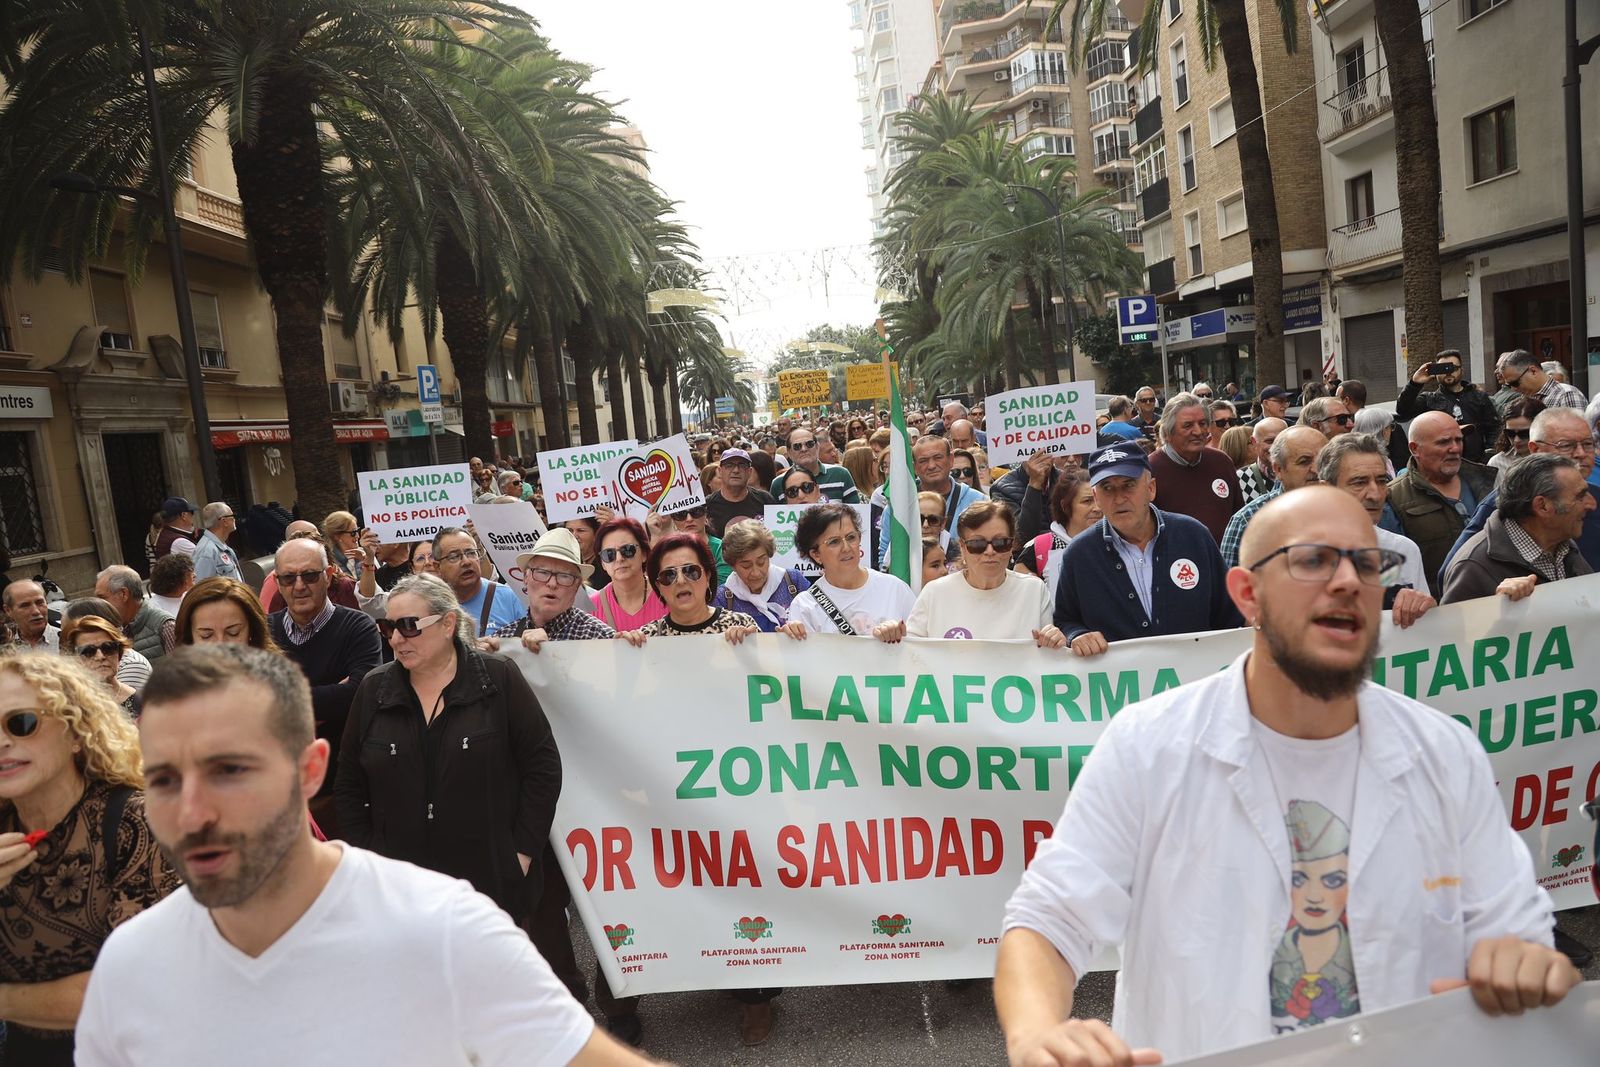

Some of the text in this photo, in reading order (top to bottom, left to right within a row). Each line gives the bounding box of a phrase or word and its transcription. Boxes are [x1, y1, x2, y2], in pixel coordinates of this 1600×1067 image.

[1128, 299, 1147, 324] P
[1131, 332, 1147, 341] LIBRE
[422, 370, 434, 399] P
[999, 390, 1079, 414] SANIDAD
[1004, 409, 1076, 430] PÚBLICA
[992, 424, 1091, 448] Y DE CALIDAD
[1017, 443, 1066, 457] ALAEDA
[548, 457, 567, 470] LA
[628, 460, 667, 482] SANIDAD
[369, 471, 465, 491] LA SANIDAD
[385, 489, 449, 506] PÚBLICA
[556, 490, 579, 503] NO
[583, 487, 598, 499] SE
[371, 506, 466, 524] NO ES POLÍTICA
[662, 500, 700, 513] ALAMEDA
[488, 529, 541, 544] Sanidad
[814, 591, 836, 614] BIMBA
[676, 742, 858, 799] ZONA
[1510, 765, 1574, 832] DE
[651, 827, 762, 888] UNA
[777, 817, 1004, 888] SANIDAD
[1562, 875, 1590, 887] NORTE
[701, 946, 807, 957] PLATAFORMA SANITARIA
[839, 940, 945, 951] PLATAFORMA SANITARIA
[622, 952, 669, 963] SANITARIA
[726, 957, 782, 967] ZONA NORTE
[864, 952, 921, 961] ZONA NORTE
